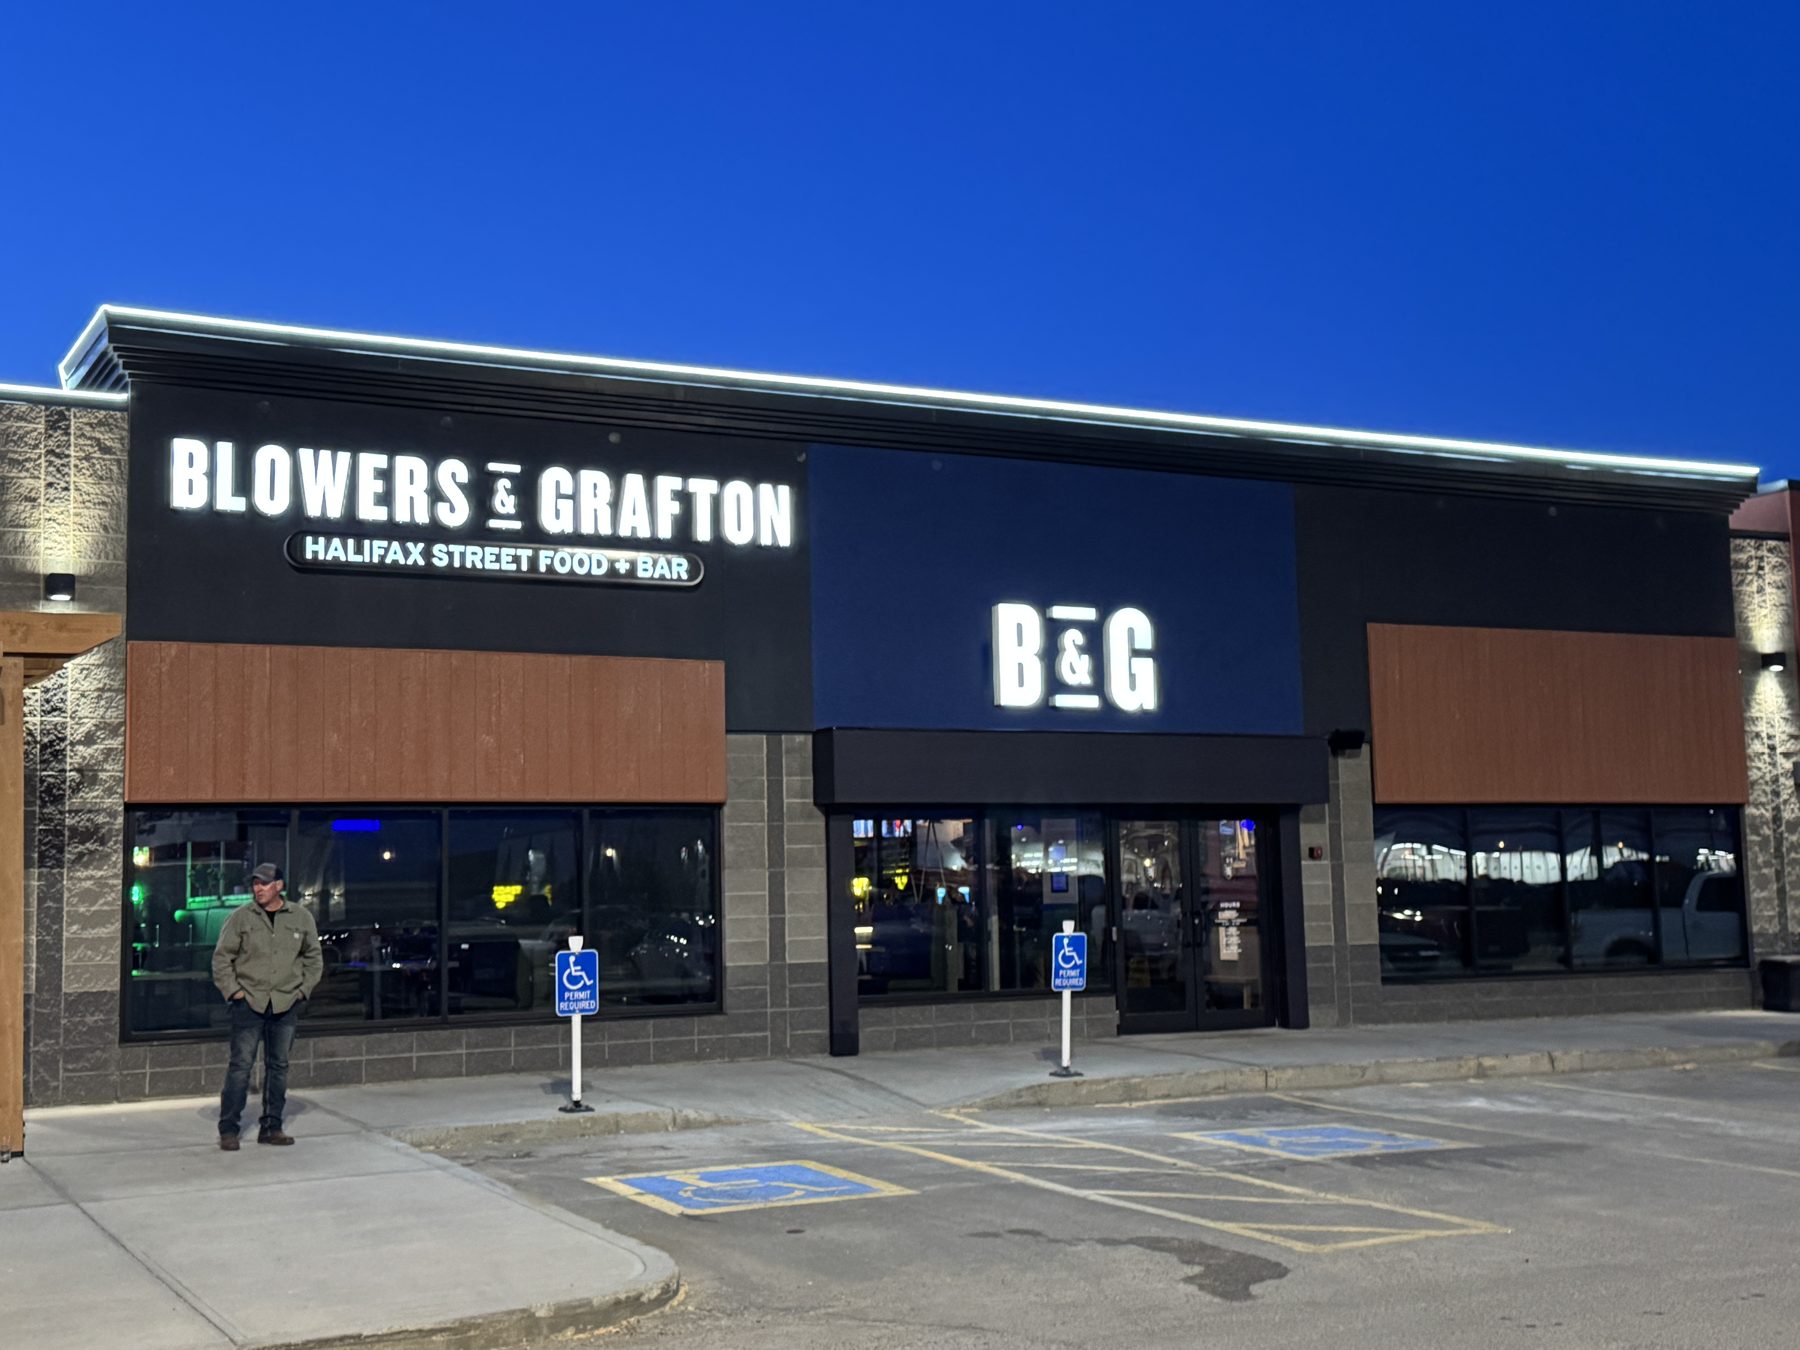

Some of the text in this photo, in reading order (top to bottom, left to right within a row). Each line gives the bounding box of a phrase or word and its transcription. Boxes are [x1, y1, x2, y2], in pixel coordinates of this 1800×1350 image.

[169, 437, 471, 528] BLOWERS
[537, 465, 794, 548] GRAFTON
[304, 535, 690, 581] HALIFAX STREET FOOD + BAR
[1058, 968, 1081, 978] PERMIT
[1054, 977, 1084, 987] REQUIRED
[564, 990, 591, 1001] PERMIT
[559, 1000, 596, 1011] REQUIRED
